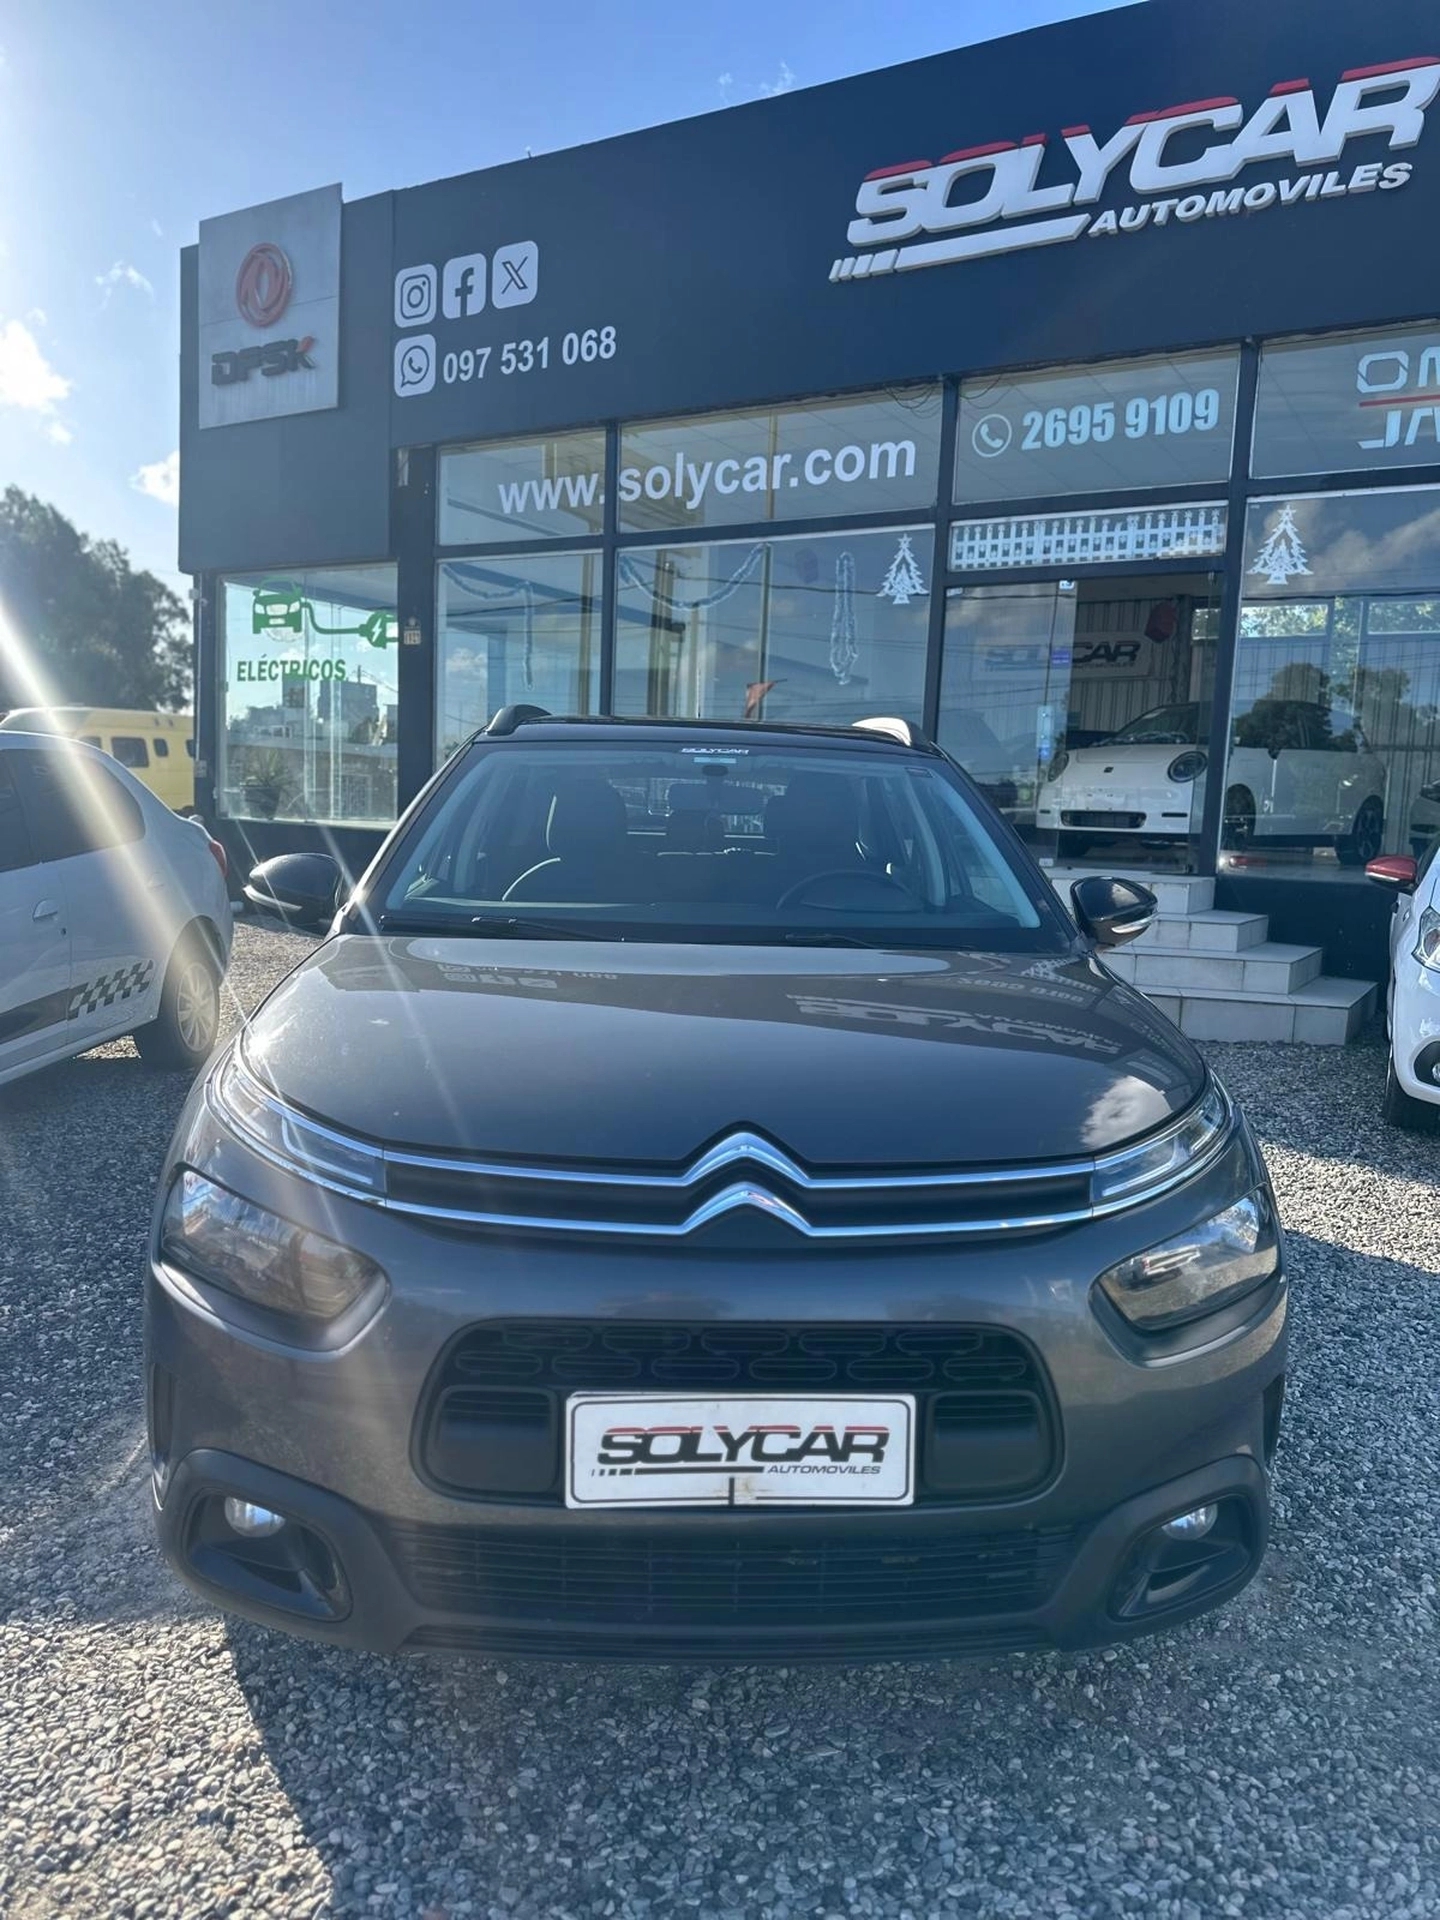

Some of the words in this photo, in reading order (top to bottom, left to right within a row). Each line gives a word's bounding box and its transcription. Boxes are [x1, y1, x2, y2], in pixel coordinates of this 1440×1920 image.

[846, 56, 1440, 247] SOLYCAR
[1088, 161, 1413, 237] AUTOMOVILES
[443, 345, 492, 384] 097
[500, 335, 550, 375] 531
[562, 325, 617, 366] 068
[1021, 402, 1116, 451] 2695
[1124, 388, 1220, 438] 9109
[236, 653, 347, 682] ELÉCTRICOS
[597, 1425, 889, 1465] SOLYCAR
[766, 1464, 881, 1476] AUTOMOVILES
